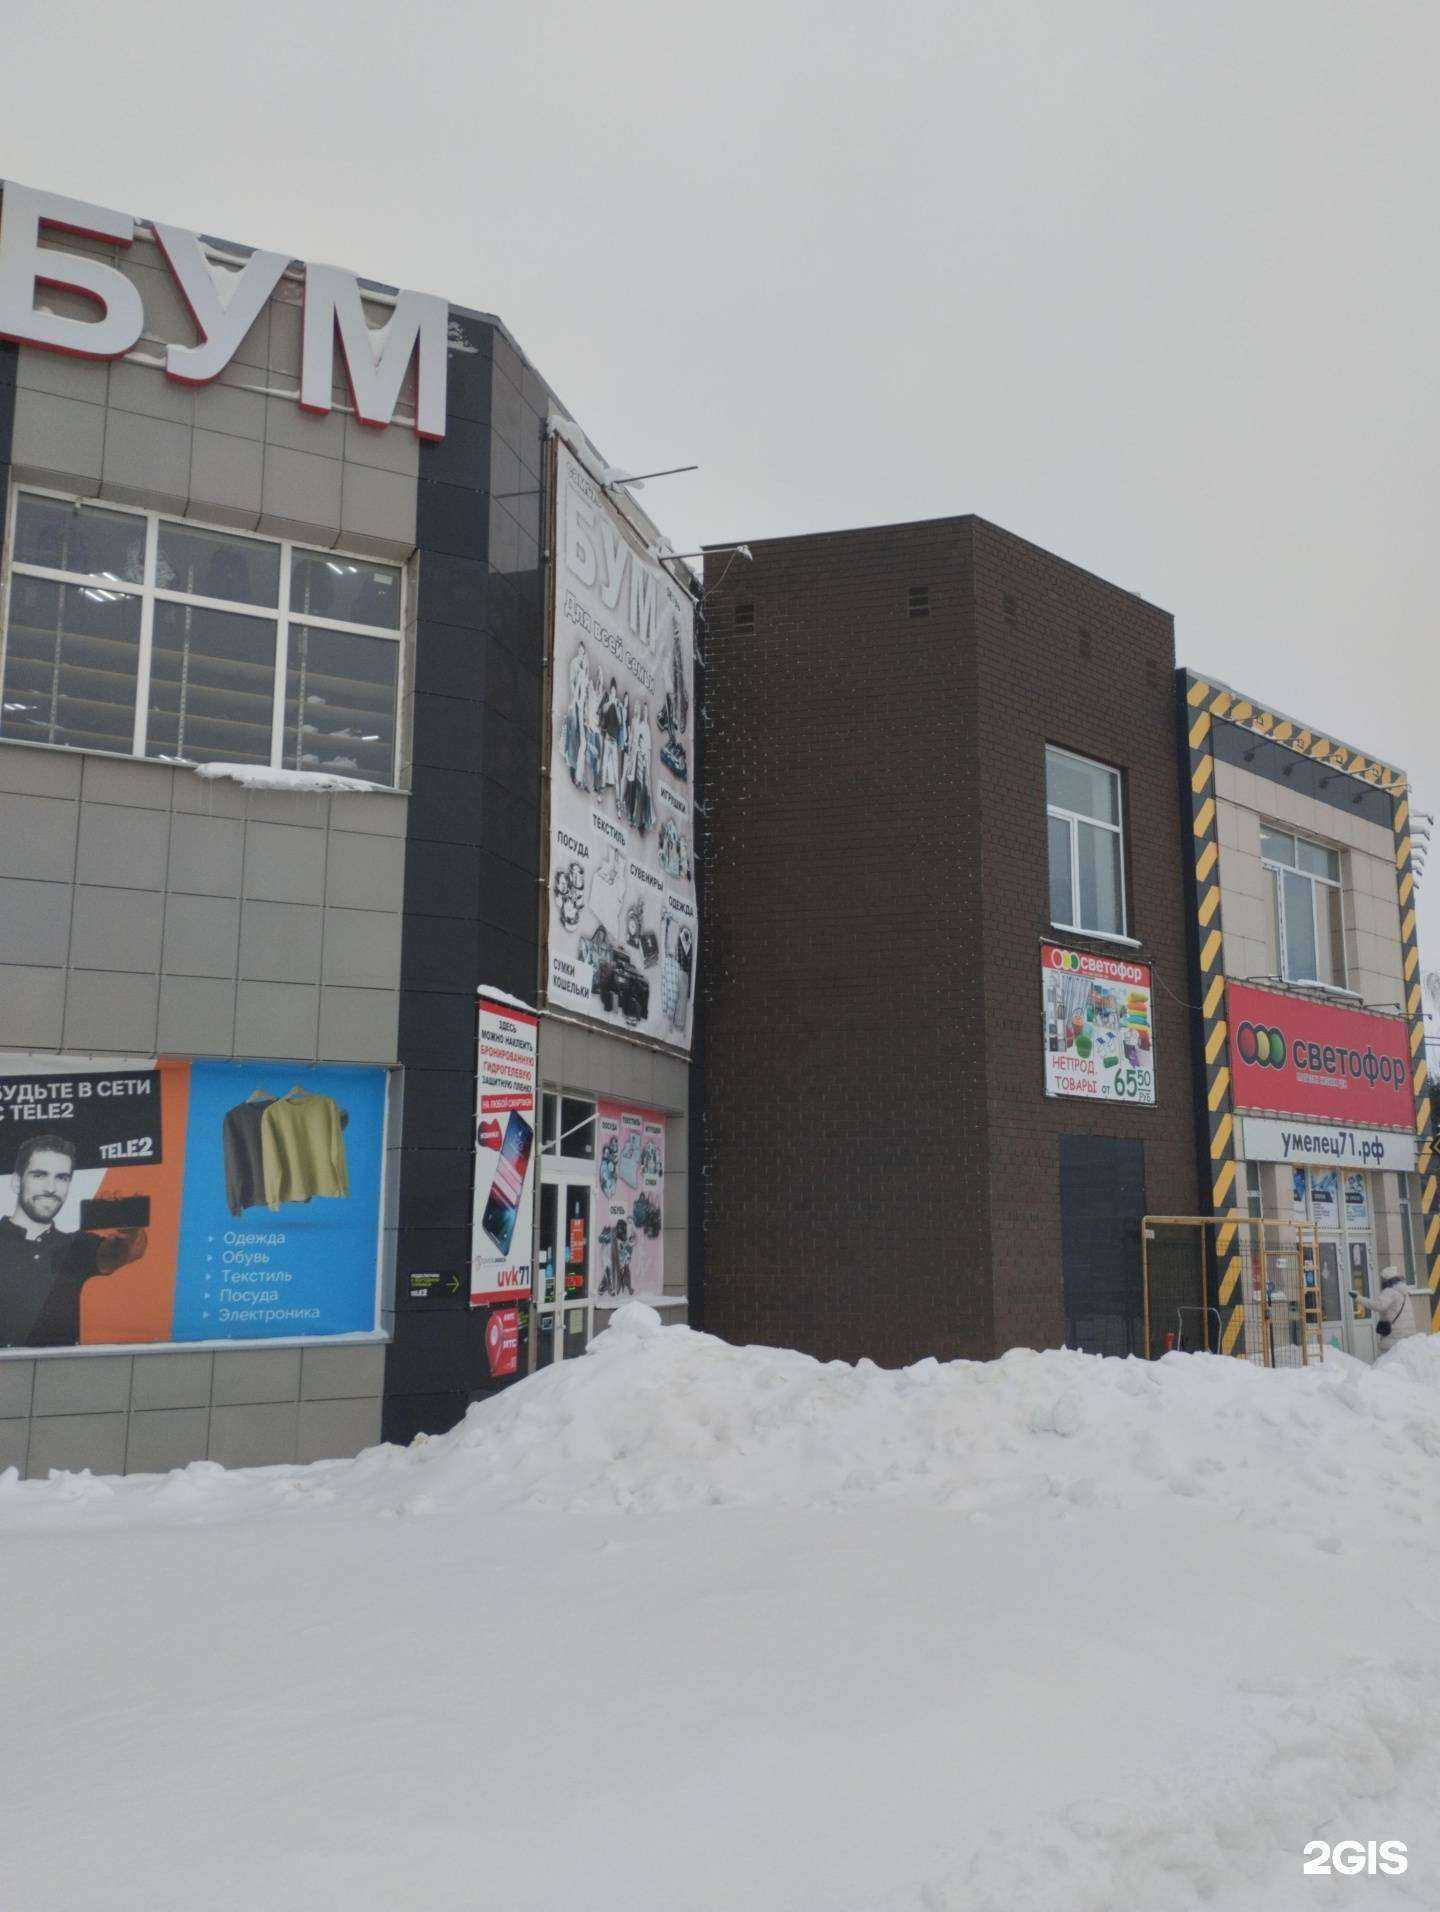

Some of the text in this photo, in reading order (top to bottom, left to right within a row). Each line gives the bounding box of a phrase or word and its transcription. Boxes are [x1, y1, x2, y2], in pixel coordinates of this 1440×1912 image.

[0, 178, 449, 441] БУМ
[564, 478, 658, 656] БУМ
[660, 787, 687, 814] ИГРУШКИ
[592, 813, 626, 847] ТЕКСТИЛЬ
[557, 830, 590, 859] ПОСУДА
[630, 863, 664, 892] СУВЕНИРЫ
[668, 895, 694, 918] ОДЕЖДА
[553, 957, 576, 977] СУМКИ
[552, 974, 590, 999] КОШЕЛЬКИ
[481, 1029, 504, 1044] МОЖНО
[498, 1019, 518, 1034] ЗДЕСЬ
[1051, 1055, 1098, 1075] НЕПРОД.
[1292, 1038, 1407, 1092] светофор
[0, 1079, 150, 1103] УДЬТЕ В СЕТИ
[1055, 1075, 1098, 1094] ТОВАРЫ
[1114, 1067, 1138, 1098] 65
[1137, 1069, 1152, 1088] 50
[10, 1103, 74, 1120] TELE2
[99, 1137, 153, 1159] TELE2
[1281, 1131, 1385, 1165] умелец71.рф
[224, 1231, 286, 1246] Одежда
[222, 1249, 270, 1266] Обувь
[222, 1269, 292, 1282] Текстиль
[497, 1265, 530, 1288] uvk71
[220, 1288, 278, 1305] Посуда
[218, 1307, 320, 1323] Электроника
